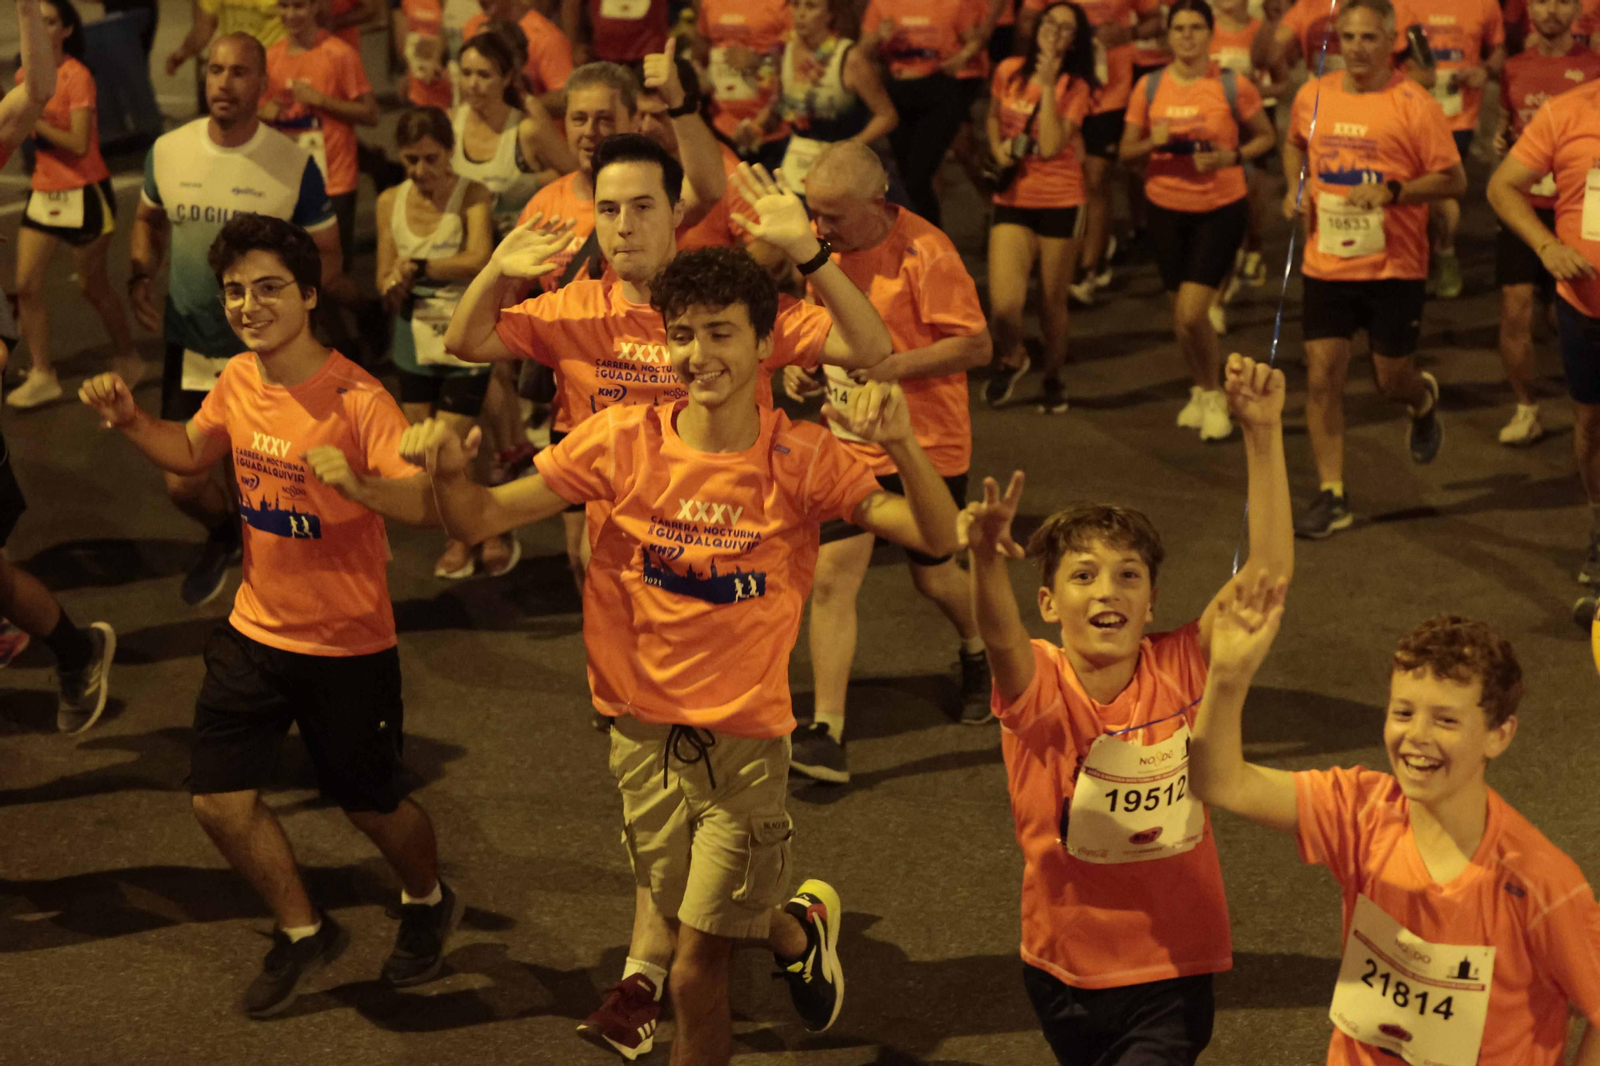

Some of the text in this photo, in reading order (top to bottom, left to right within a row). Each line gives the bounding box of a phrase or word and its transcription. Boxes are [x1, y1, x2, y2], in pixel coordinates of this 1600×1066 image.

[618, 342, 670, 363] XXXV
[595, 358, 675, 374] CARRERA NOCTU
[600, 368, 683, 384] GUADALQUIV
[251, 431, 292, 458] XXXV
[235, 446, 264, 462] CARRERA
[266, 456, 305, 473] NOCTURNA
[240, 458, 306, 484] GUADALQUIVIR
[676, 498, 744, 526] XXXV
[651, 515, 699, 533] CARRERA
[704, 525, 762, 540] NOCTURNA
[1105, 774, 1187, 813] 19512
[1361, 958, 1454, 1021] 21814
